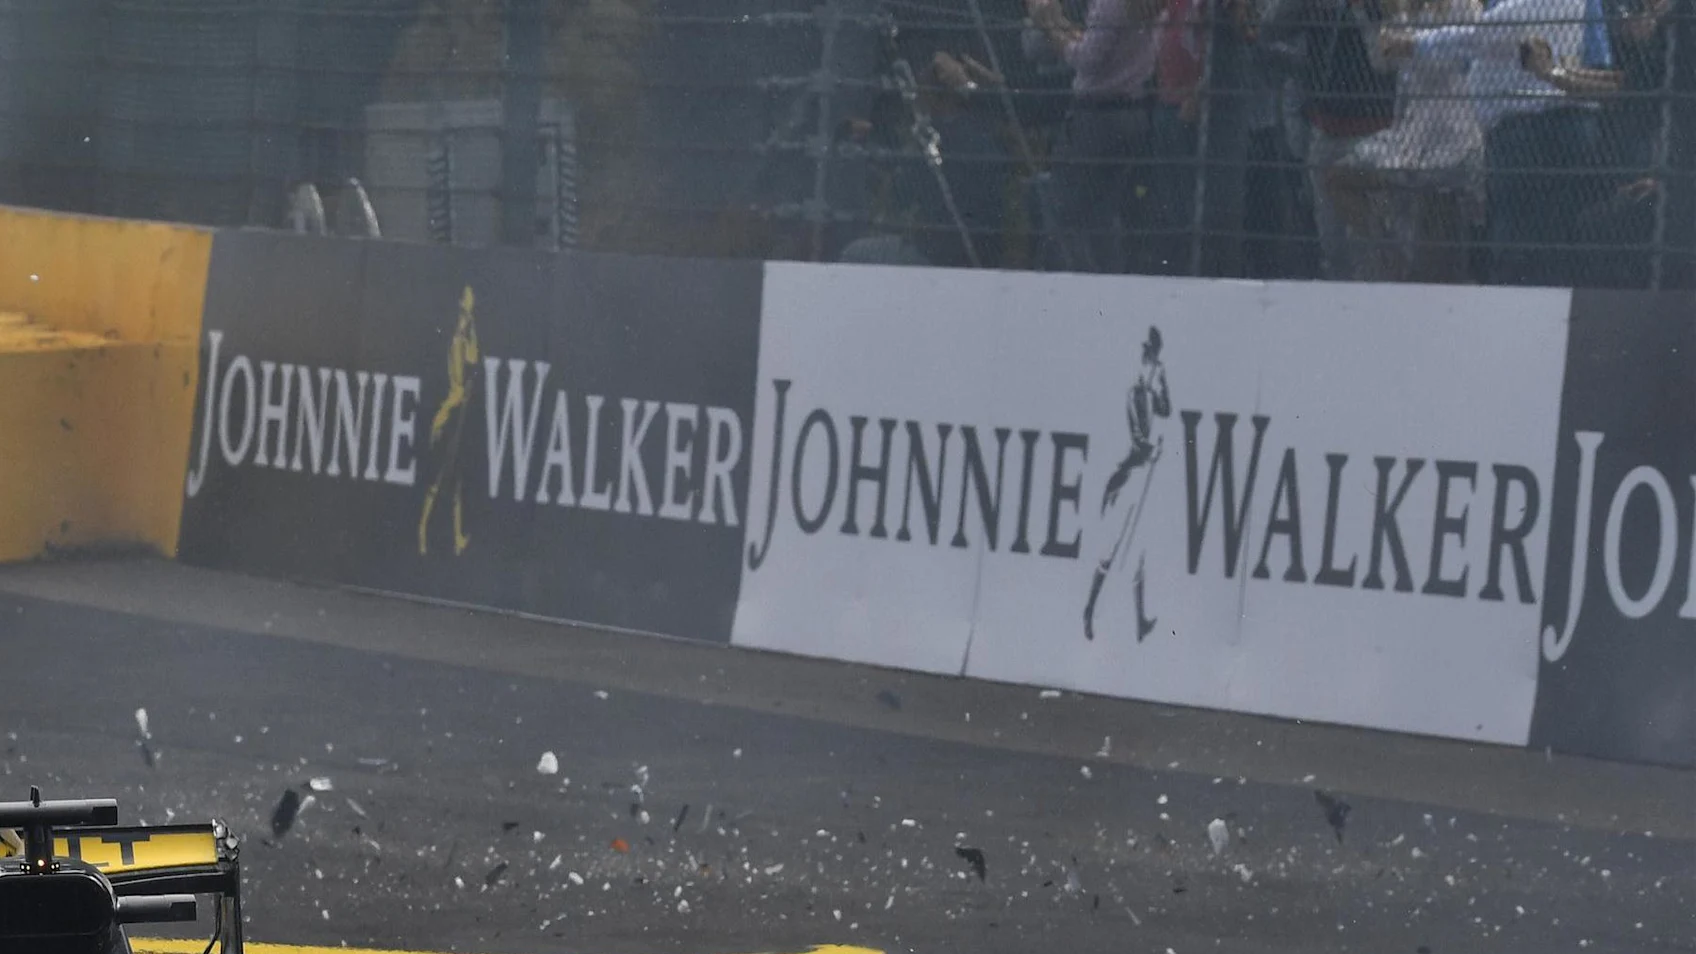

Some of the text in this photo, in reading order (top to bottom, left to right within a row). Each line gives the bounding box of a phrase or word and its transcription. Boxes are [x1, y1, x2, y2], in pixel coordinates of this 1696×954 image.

[186, 330, 744, 527] JOHNNIE WALKER
[748, 378, 1541, 605] JOHNNIE WALKER
[1542, 430, 1696, 662] JO
